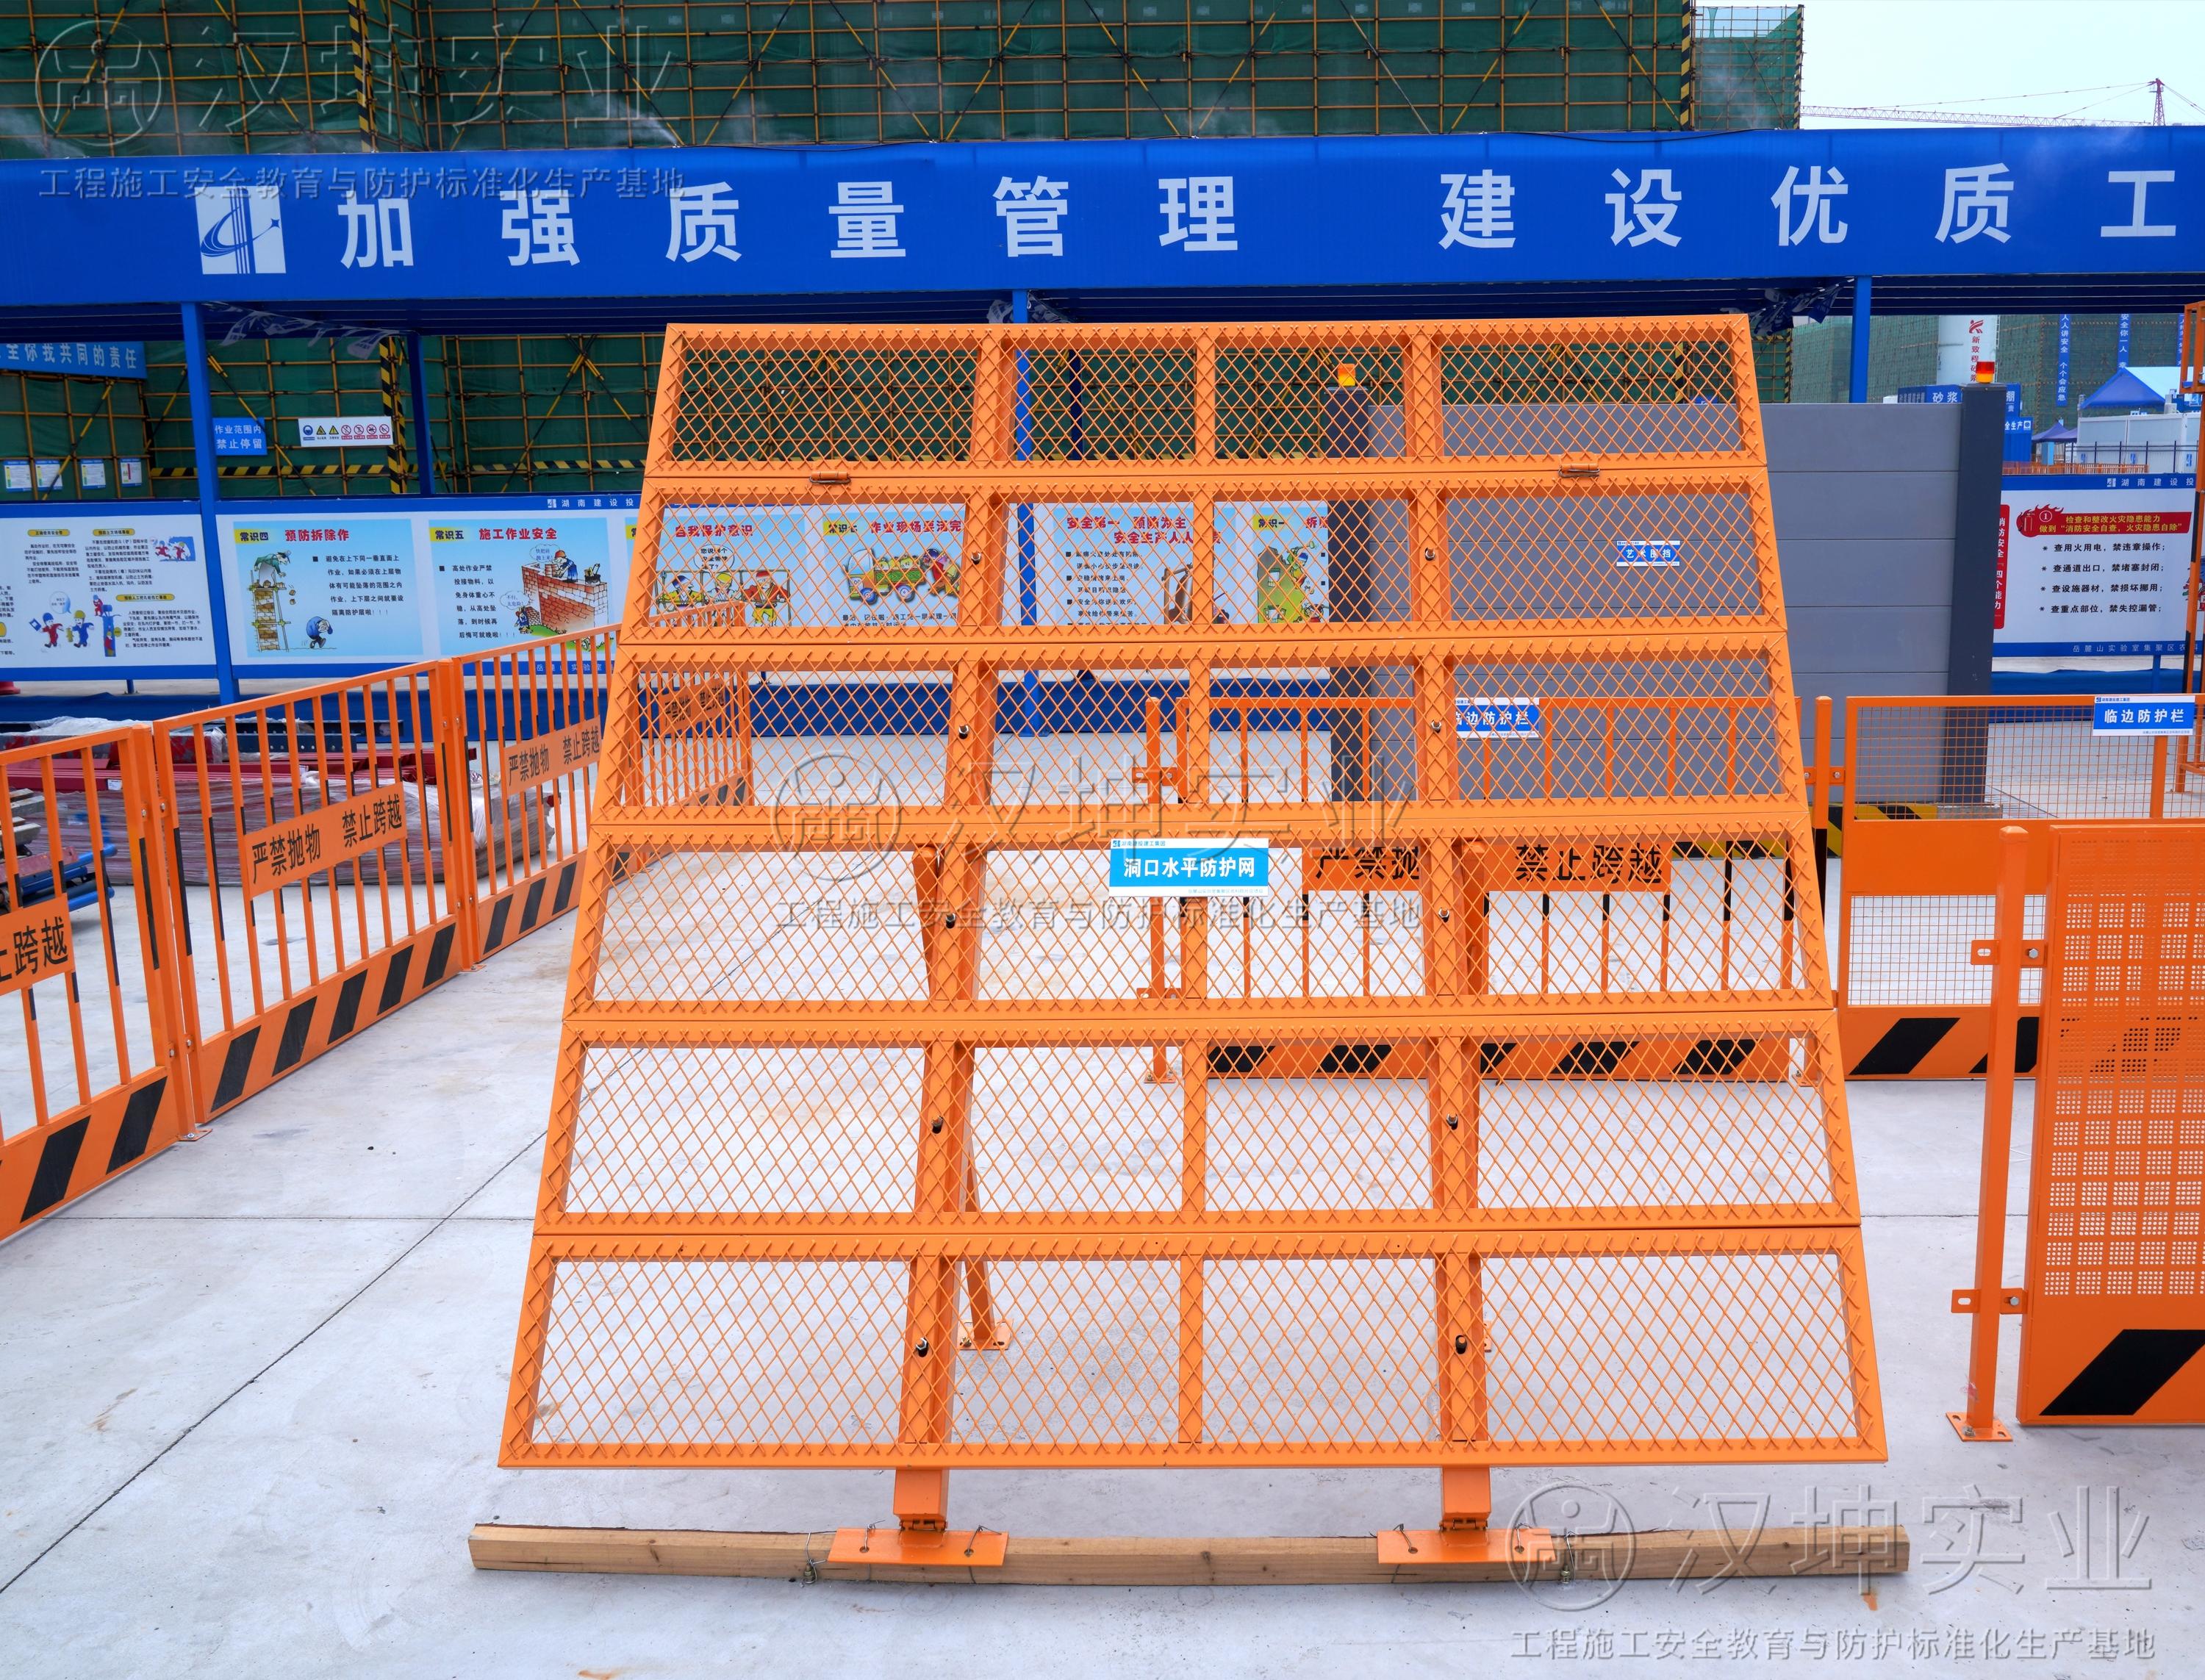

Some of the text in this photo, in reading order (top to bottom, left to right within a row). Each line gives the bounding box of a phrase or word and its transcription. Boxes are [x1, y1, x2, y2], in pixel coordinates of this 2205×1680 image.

[340, 162, 2176, 268] 加强质量管理 建设优质工
[215, 425, 262, 434] 作业范围内
[217, 439, 262, 448] 禁止停留
[2121, 478, 2194, 487] 湖南建设投
[562, 498, 634, 507] 湖南建设投
[2066, 515, 2161, 524] 检查和整改火灾隐患能力
[240, 528, 350, 542] 常识四 预防拆除作
[435, 528, 557, 540] 常识五 施工作业安全
[675, 524, 753, 538] 自我保护意识
[1114, 531, 1221, 544] 安全生产人人责
[2104, 709, 2184, 723] 临边防护栏
[509, 725, 600, 786] 严禁抛物 禁止跨越
[253, 792, 403, 884] 严禁抛物 禁止跨越
[1124, 857, 1255, 878] 洞口水平防护网
[1515, 842, 1663, 884] 禁止跨越
